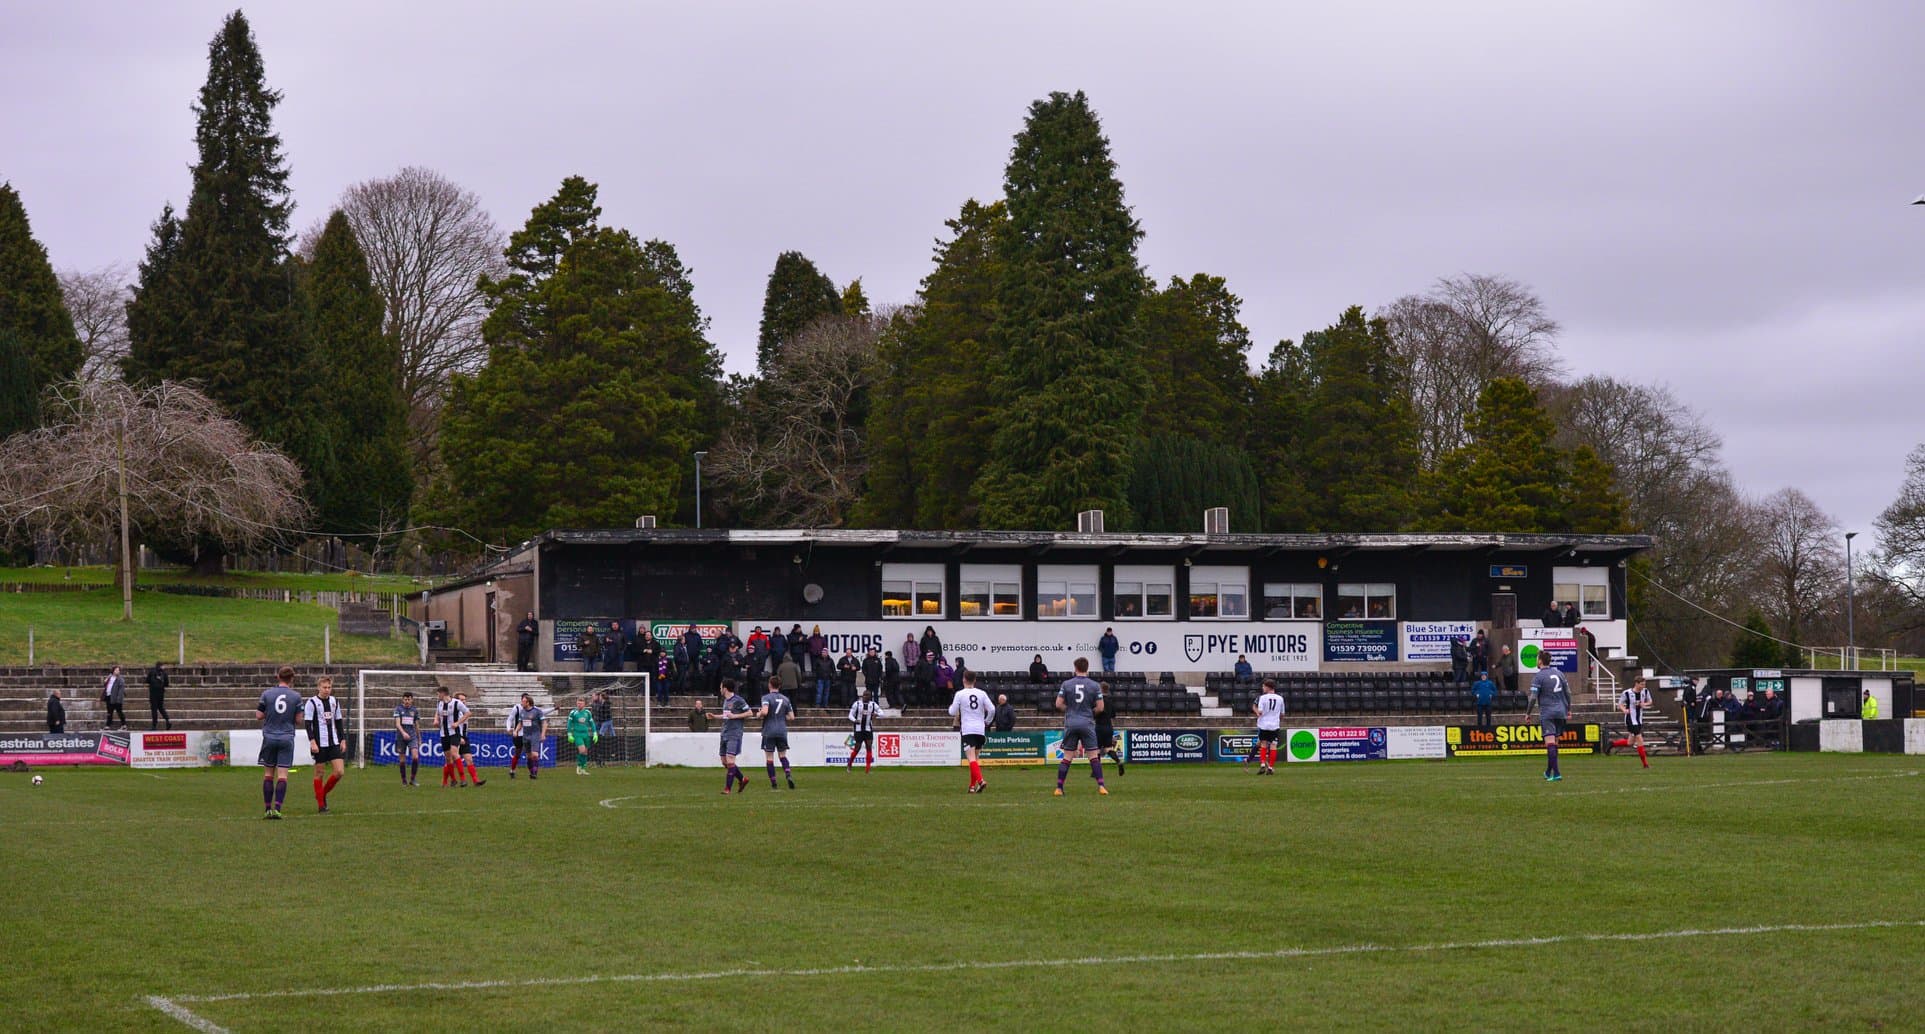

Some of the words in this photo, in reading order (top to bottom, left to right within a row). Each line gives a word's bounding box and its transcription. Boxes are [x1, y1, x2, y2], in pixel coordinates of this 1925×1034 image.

[656, 627, 668, 637] JT
[1406, 624, 1426, 632] Blue
[1428, 624, 1446, 632] Star
[943, 643, 978, 652] 816800
[991, 643, 1064, 653] pyemotors.co.uk
[1208, 635, 1238, 653] PYE
[1244, 635, 1307, 653] MOTORS
[1550, 674, 1562, 692] 2
[1075, 684, 1085, 704] 5
[274, 694, 287, 714] 6
[775, 698, 783, 714] 7
[969, 694, 978, 710] 8
[1267, 698, 1277, 711] 11
[1131, 733, 1171, 742] Kentdale
[1470, 730, 1494, 742] the
[1496, 726, 1543, 742] SIGN
[1558, 731, 1577, 741] an
[0, 737, 43, 749] astrian
[48, 737, 95, 748] estates
[104, 743, 124, 754] SOLD
